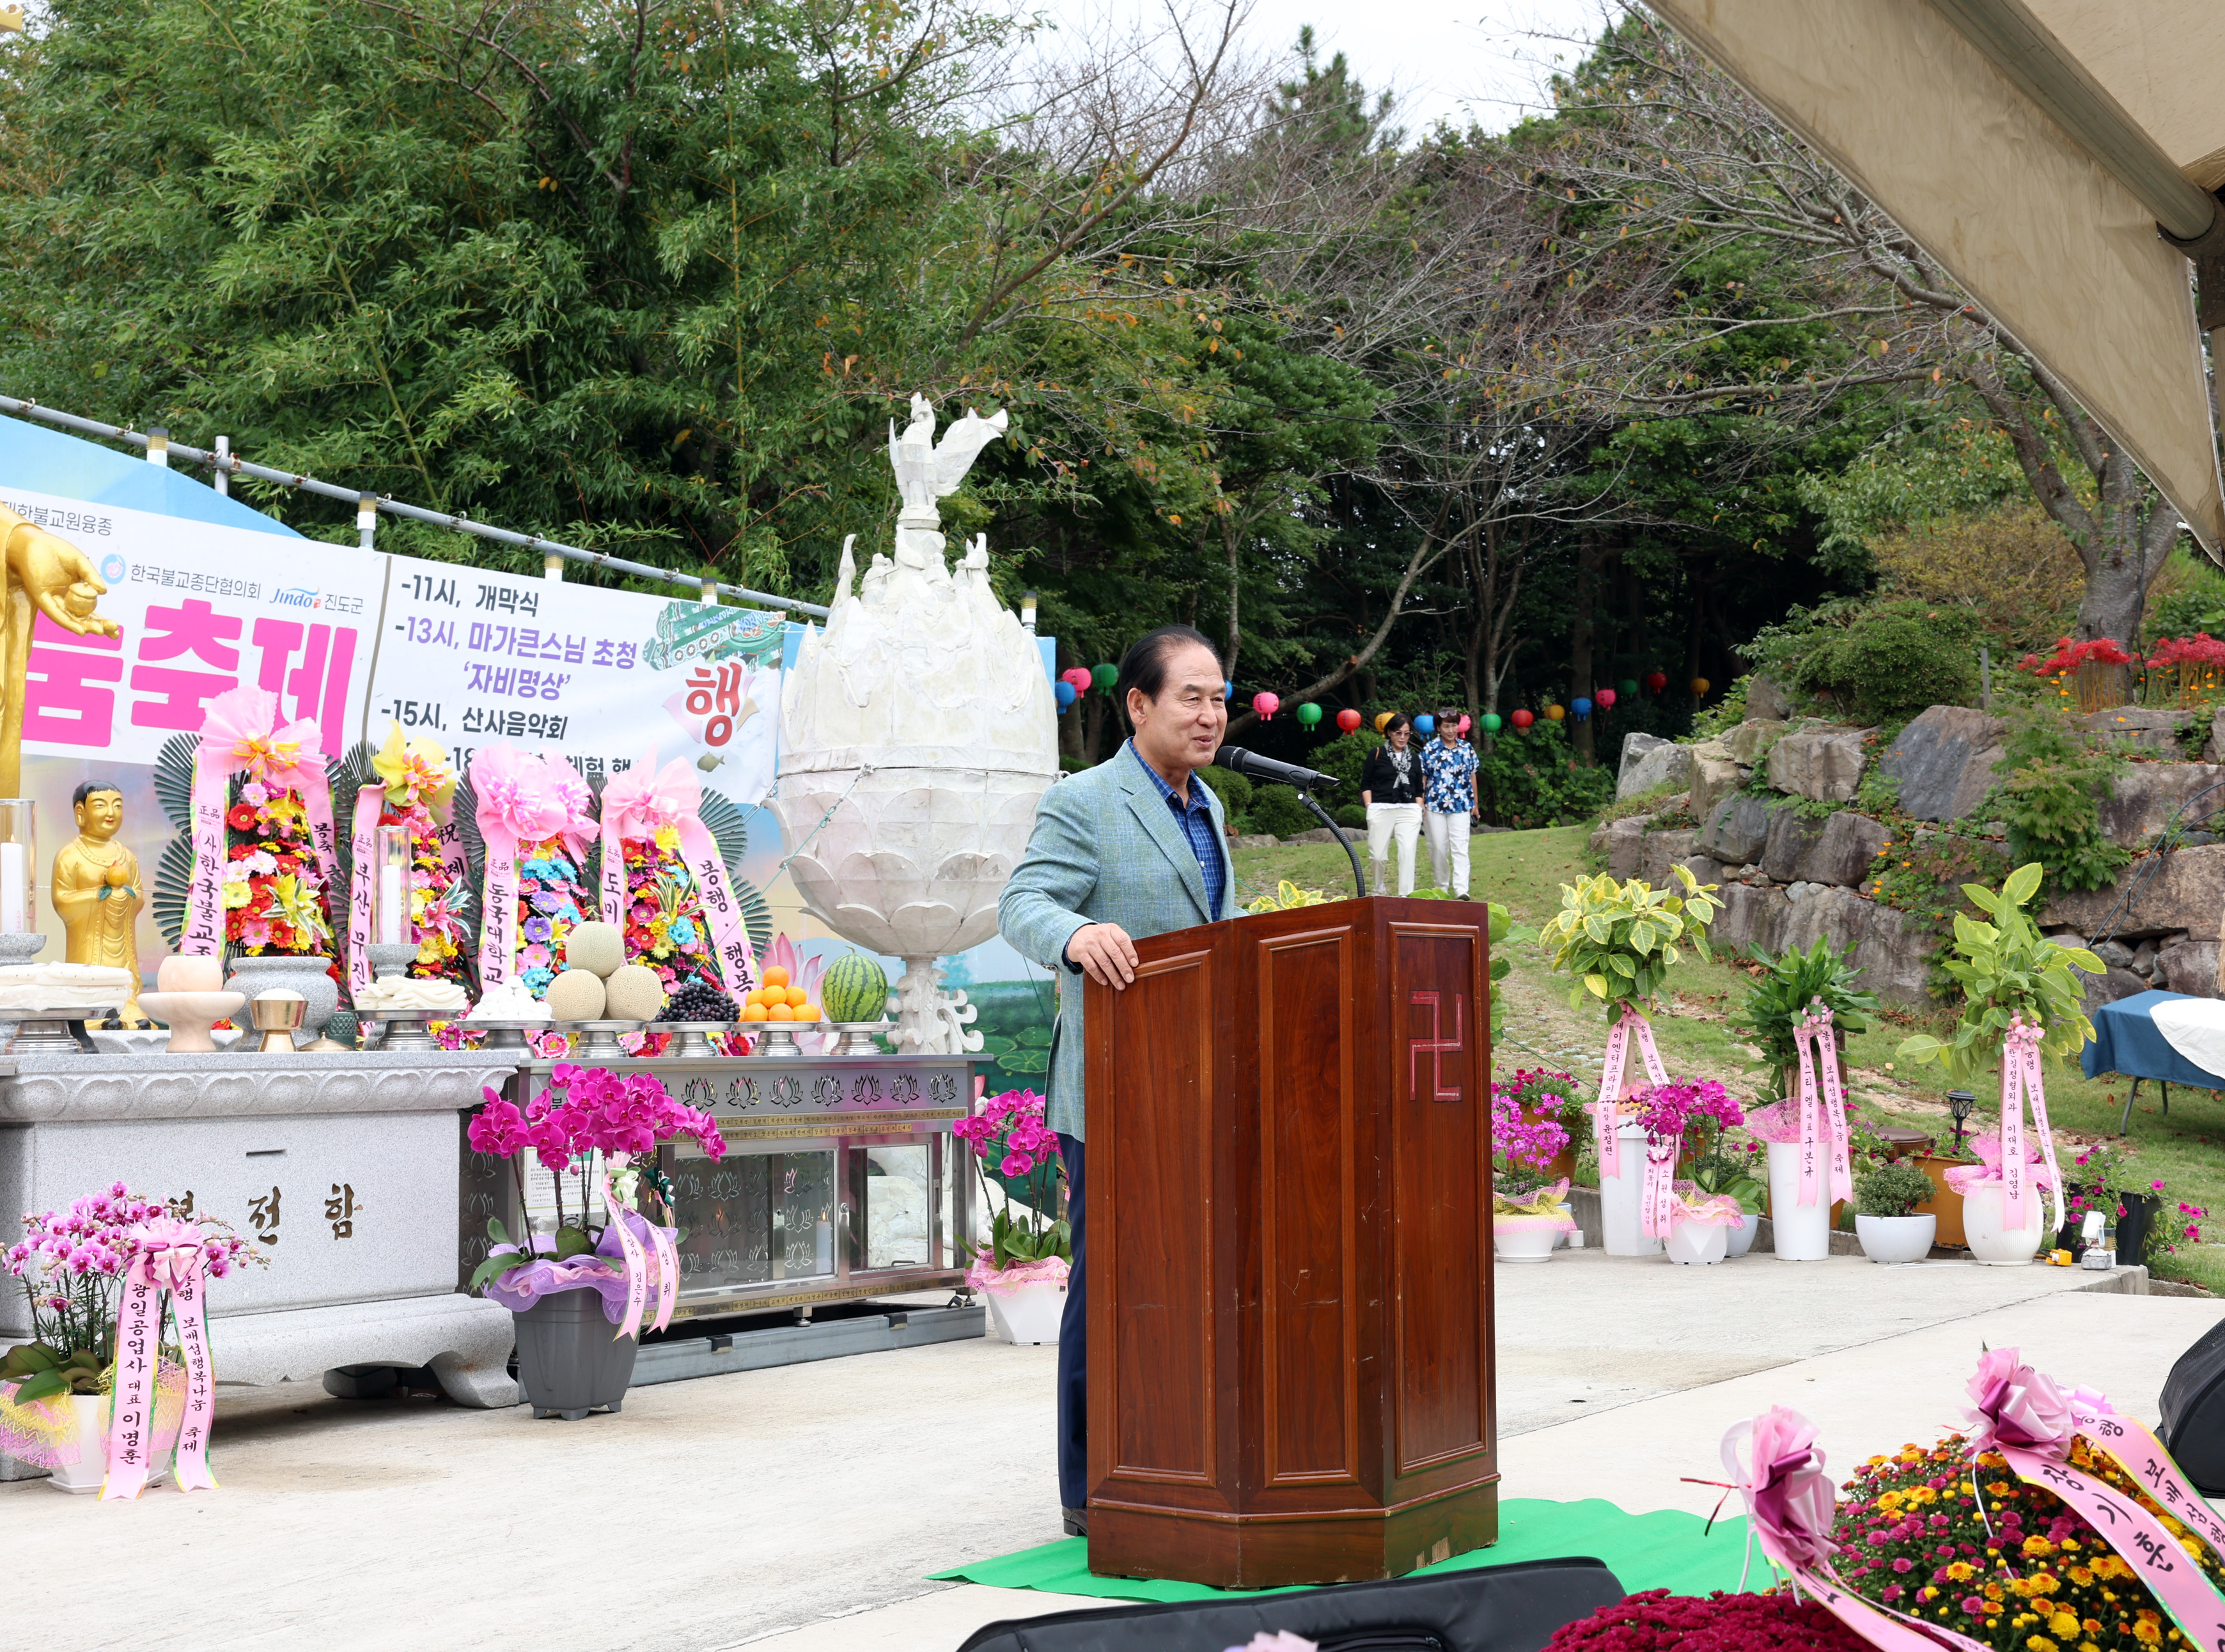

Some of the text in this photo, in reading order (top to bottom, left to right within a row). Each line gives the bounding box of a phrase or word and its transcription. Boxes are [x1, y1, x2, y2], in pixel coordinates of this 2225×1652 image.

[131, 564, 261, 600] 한국불교종단협의회
[324, 594, 363, 614] 진도군
[475, 584, 539, 618] 개막식
[468, 622, 586, 664] 마가큰스님
[592, 639, 637, 669] 초청
[685, 662, 742, 747] 행
[462, 707, 569, 740] 산사음악회
[353, 862, 371, 916] 부산
[699, 860, 728, 913] 봉행
[483, 883, 510, 985] 동국대학교
[1826, 1064, 1844, 1142] 보배섬행복나눔
[1603, 1124, 1612, 1156] 윤정현
[1806, 1114, 1813, 1131] 대표
[1804, 1137, 1814, 1178] 구본규
[2007, 1124, 2018, 1157] 이재호
[1834, 1153, 1844, 1174] 축제
[2009, 1168, 2019, 1200] 김영남
[633, 1272, 643, 1307] 김은수
[120, 1283, 151, 1465] 광일공업사 대표 이명훈
[183, 1317, 207, 1412] 보배섬행복나눔
[182, 1426, 201, 1453] 축제
